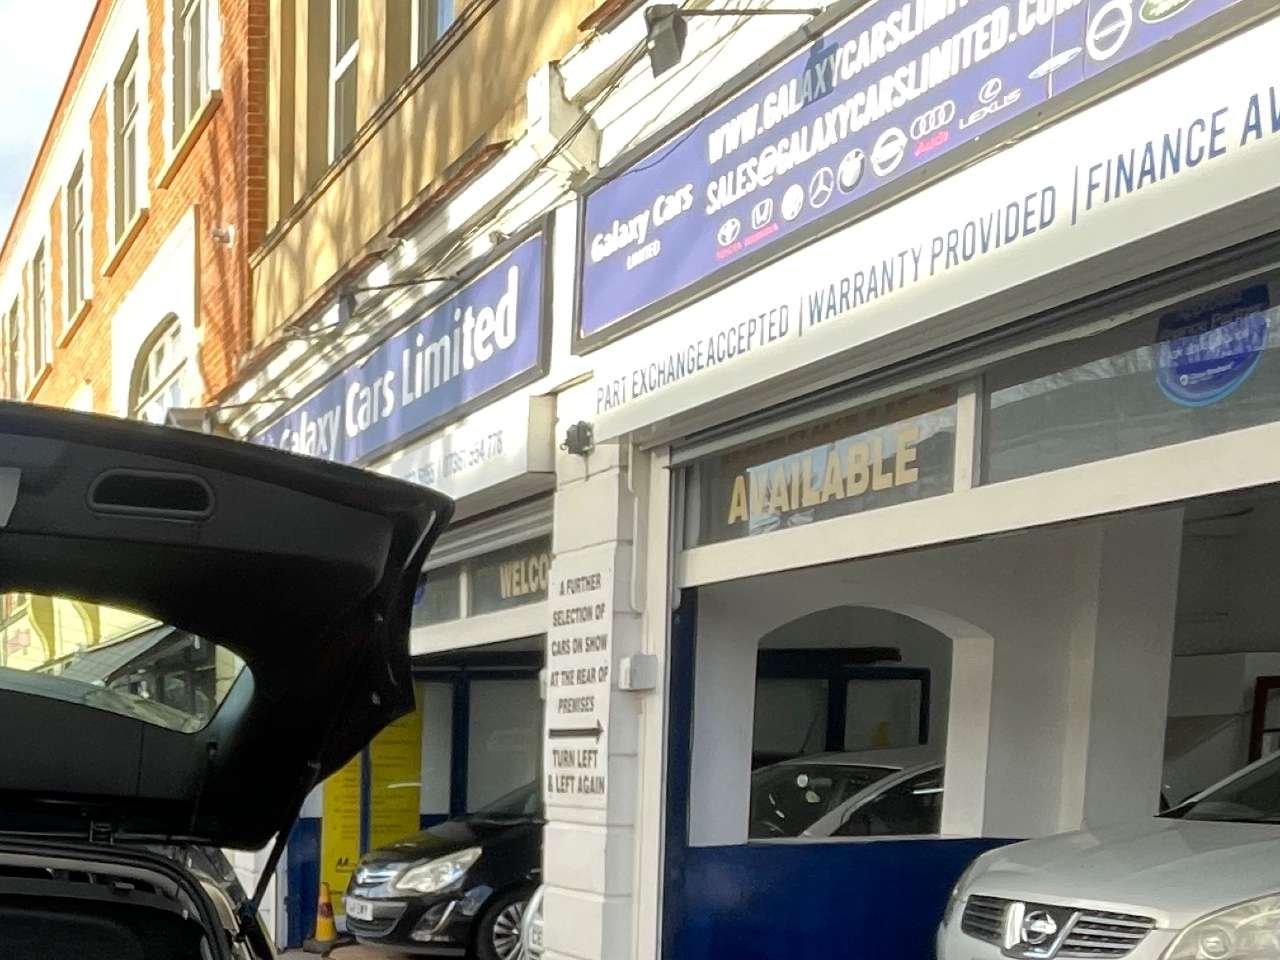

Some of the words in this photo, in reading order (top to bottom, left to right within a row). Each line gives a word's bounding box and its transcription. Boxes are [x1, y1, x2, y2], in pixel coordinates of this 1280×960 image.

[708, 0, 969, 164] WWW.GALAXYCARSLIM
[591, 209, 651, 262] Galaxy
[652, 183, 694, 227] Cars
[626, 239, 661, 271] LIMITED
[596, 376, 627, 415] PART
[930, 185, 1057, 276] PROVIDED
[345, 370, 395, 438] Cars
[402, 265, 519, 407] Limited
[728, 427, 919, 524] AVAILABLE
[500, 553, 552, 600] WELCO
[559, 580, 565, 596] A
[566, 573, 601, 594] FURTHER
[552, 606, 594, 627] SELECTION
[594, 603, 606, 620] OF
[551, 639, 571, 656] CARS
[572, 637, 583, 653] ON
[585, 634, 608, 652] SHOW
[550, 671, 560, 687] AT
[561, 669, 575, 686] THE
[577, 667, 596, 685] REAR
[598, 665, 609, 682] OF
[557, 696, 595, 713] PREMISES
[552, 750, 575, 768] TURN
[577, 749, 598, 768] LEFT
[555, 776, 575, 794] LEFT
[577, 775, 605, 794] AGAIN
